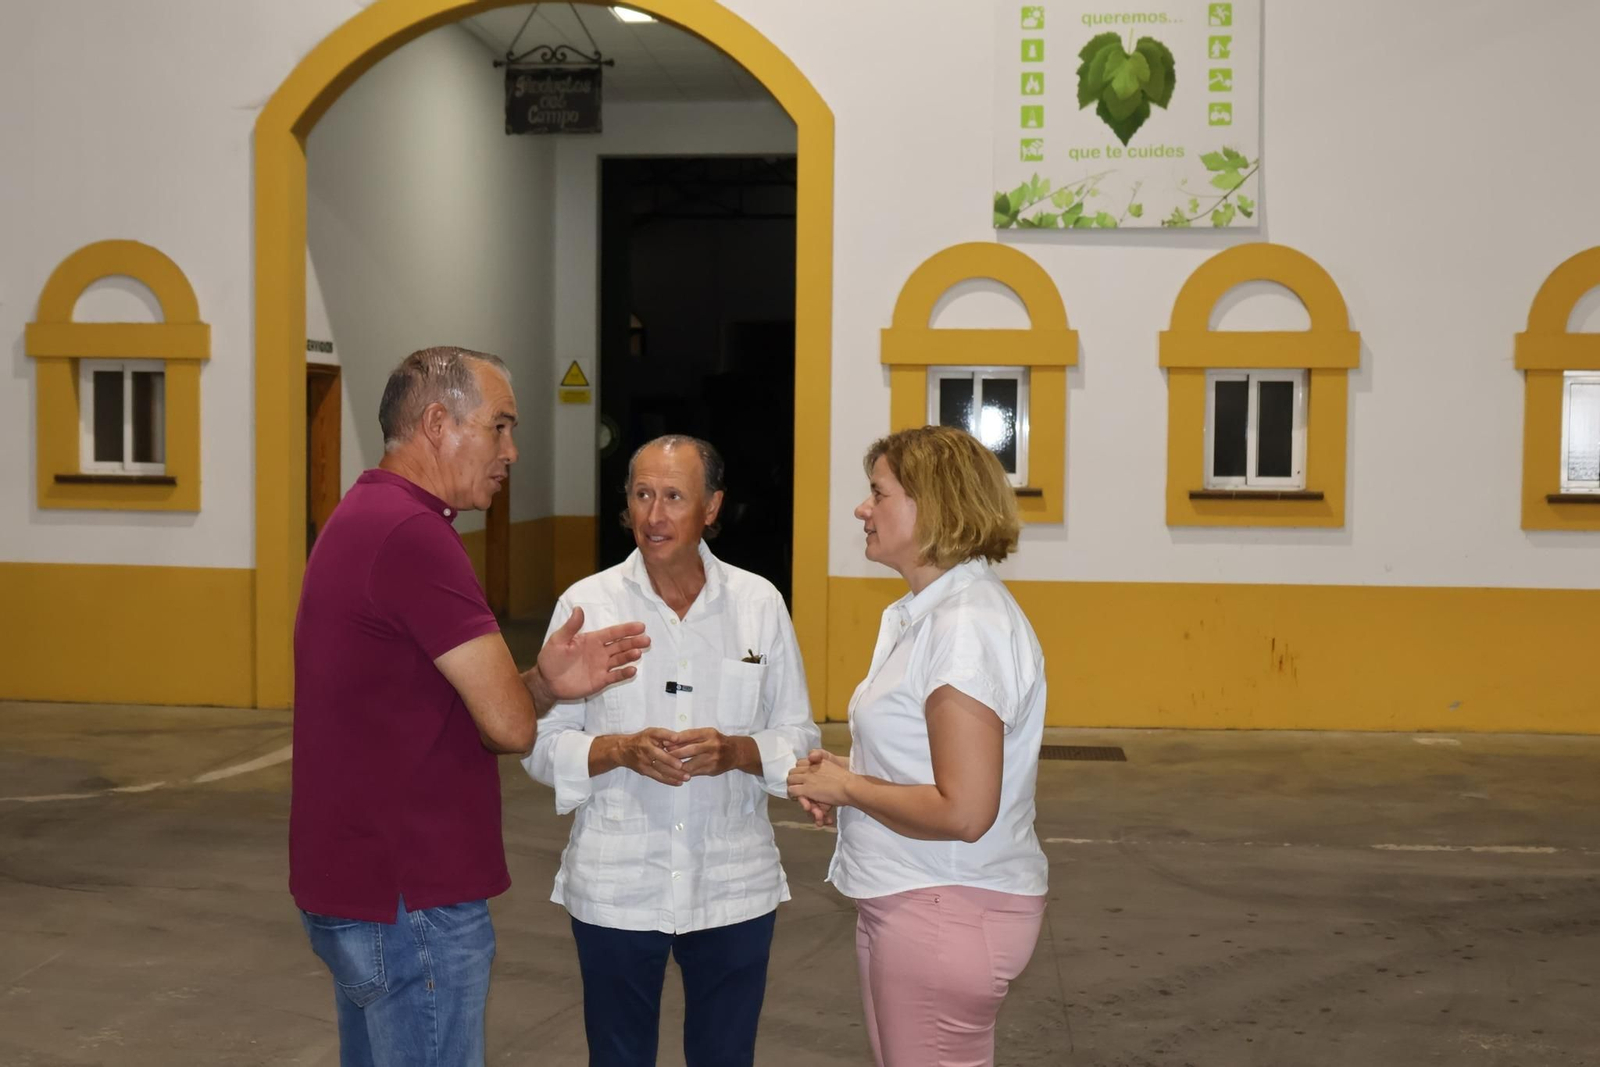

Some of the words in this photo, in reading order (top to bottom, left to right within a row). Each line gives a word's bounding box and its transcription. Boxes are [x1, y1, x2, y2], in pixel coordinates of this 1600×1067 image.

[1081, 11, 1183, 26] queremos...
[528, 105, 579, 128] Campo
[1068, 148, 1101, 162] que
[1106, 145, 1123, 158] te
[1127, 144, 1185, 158] cuides
